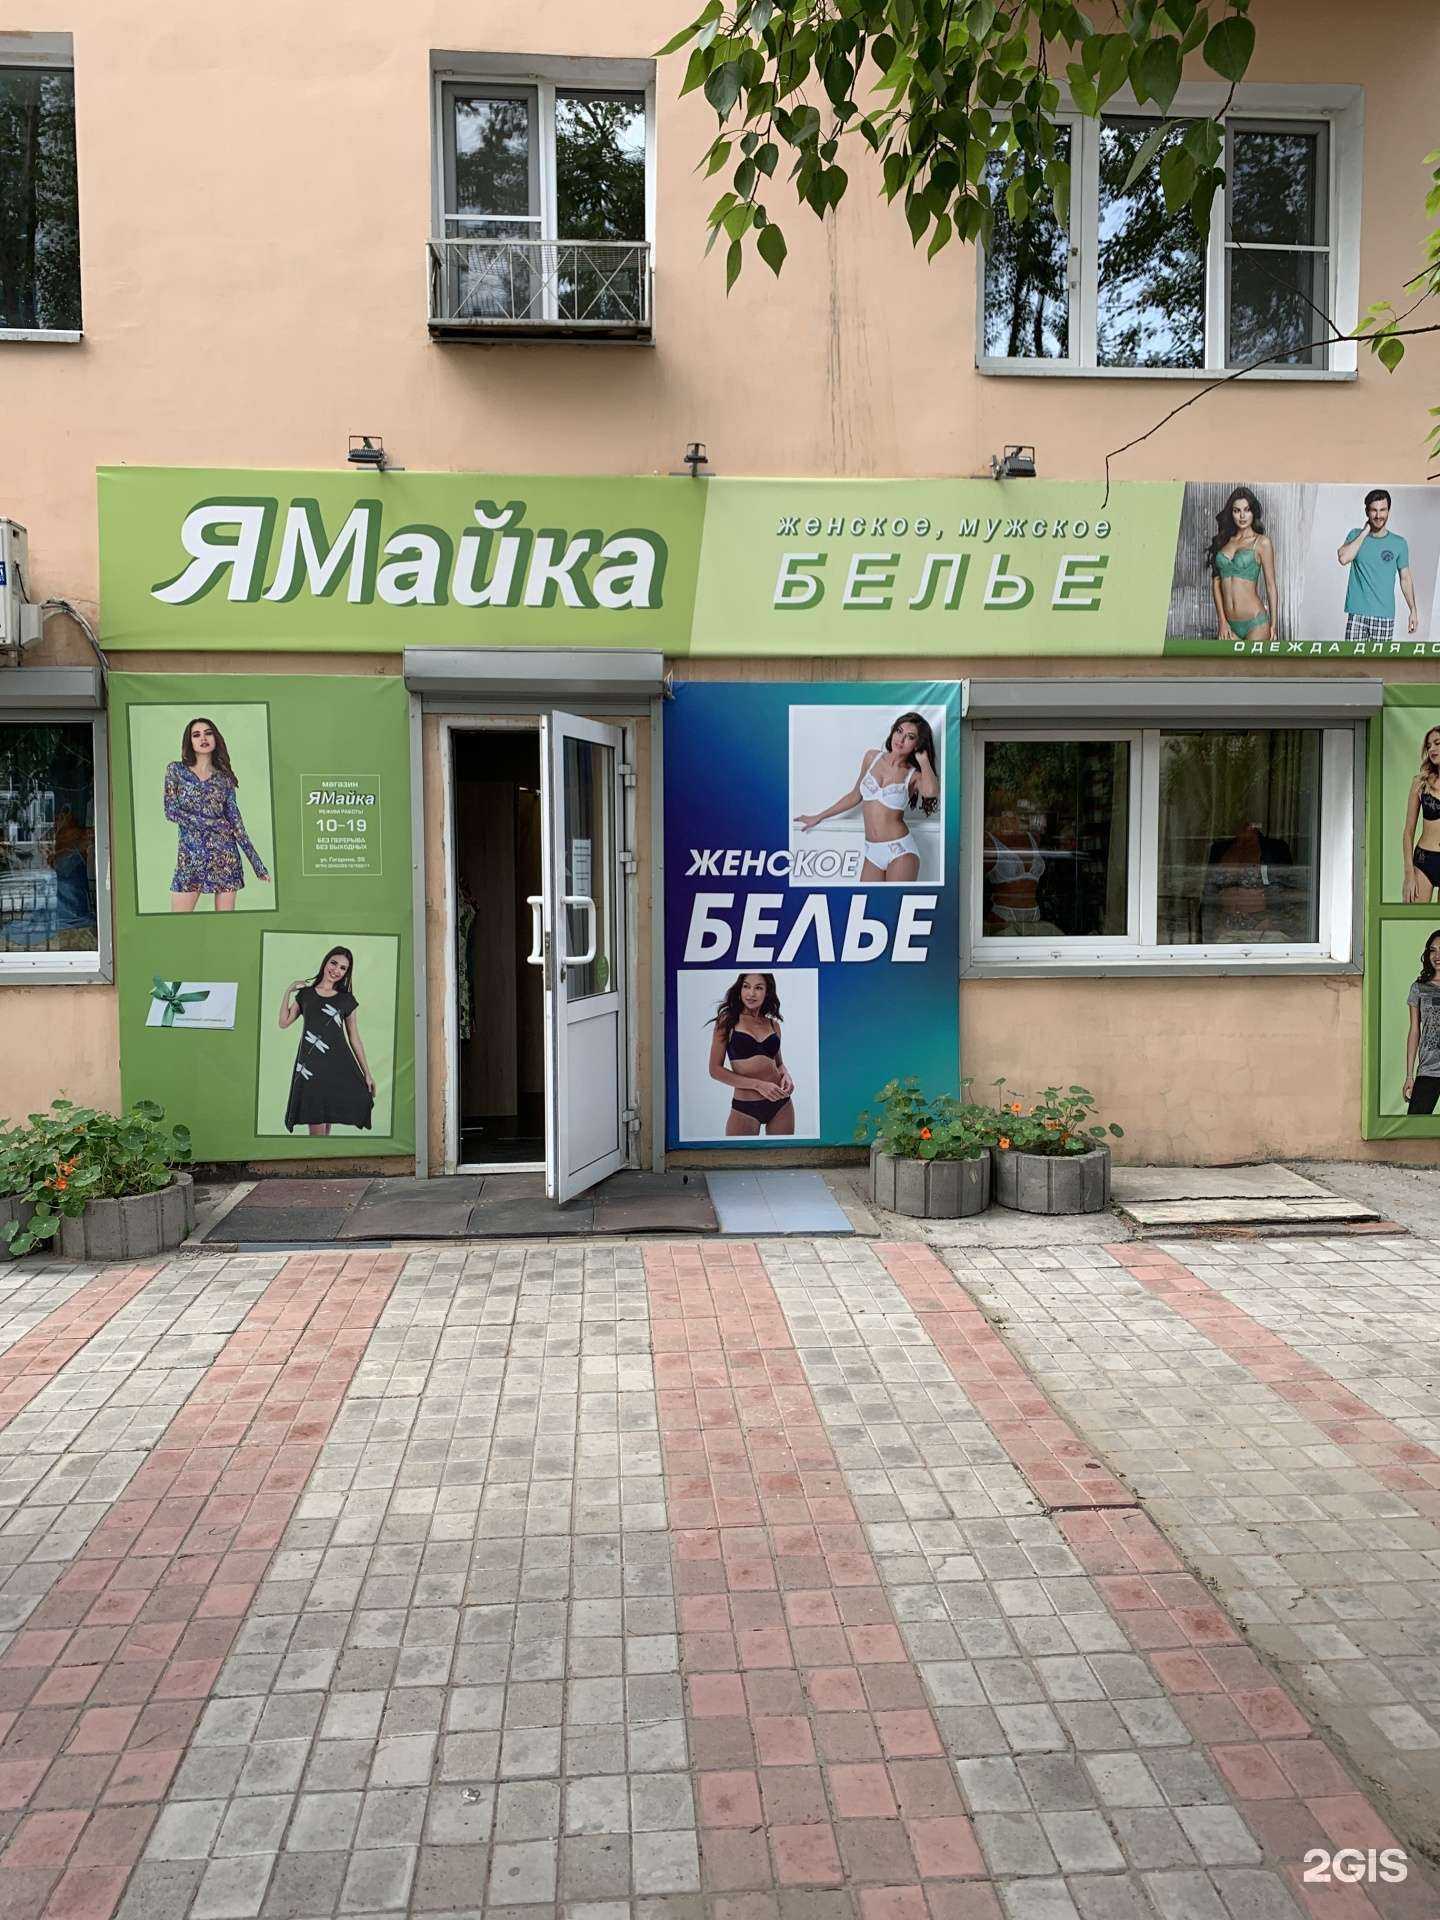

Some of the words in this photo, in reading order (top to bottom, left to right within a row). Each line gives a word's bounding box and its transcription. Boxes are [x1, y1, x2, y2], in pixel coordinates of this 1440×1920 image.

[776, 513, 944, 541] женское,
[958, 516, 1112, 543] мужское
[150, 496, 668, 610] ЯМайка
[773, 552, 1110, 611] БЕЛЬЕ
[1233, 641, 1341, 655] ОДЕЖДА
[1353, 642, 1401, 655] ДЛЯ
[306, 790, 376, 806] ЯМайка
[685, 849, 860, 877] ЖЕНСКОЕ
[684, 893, 938, 962] БЕЛЬЕ
